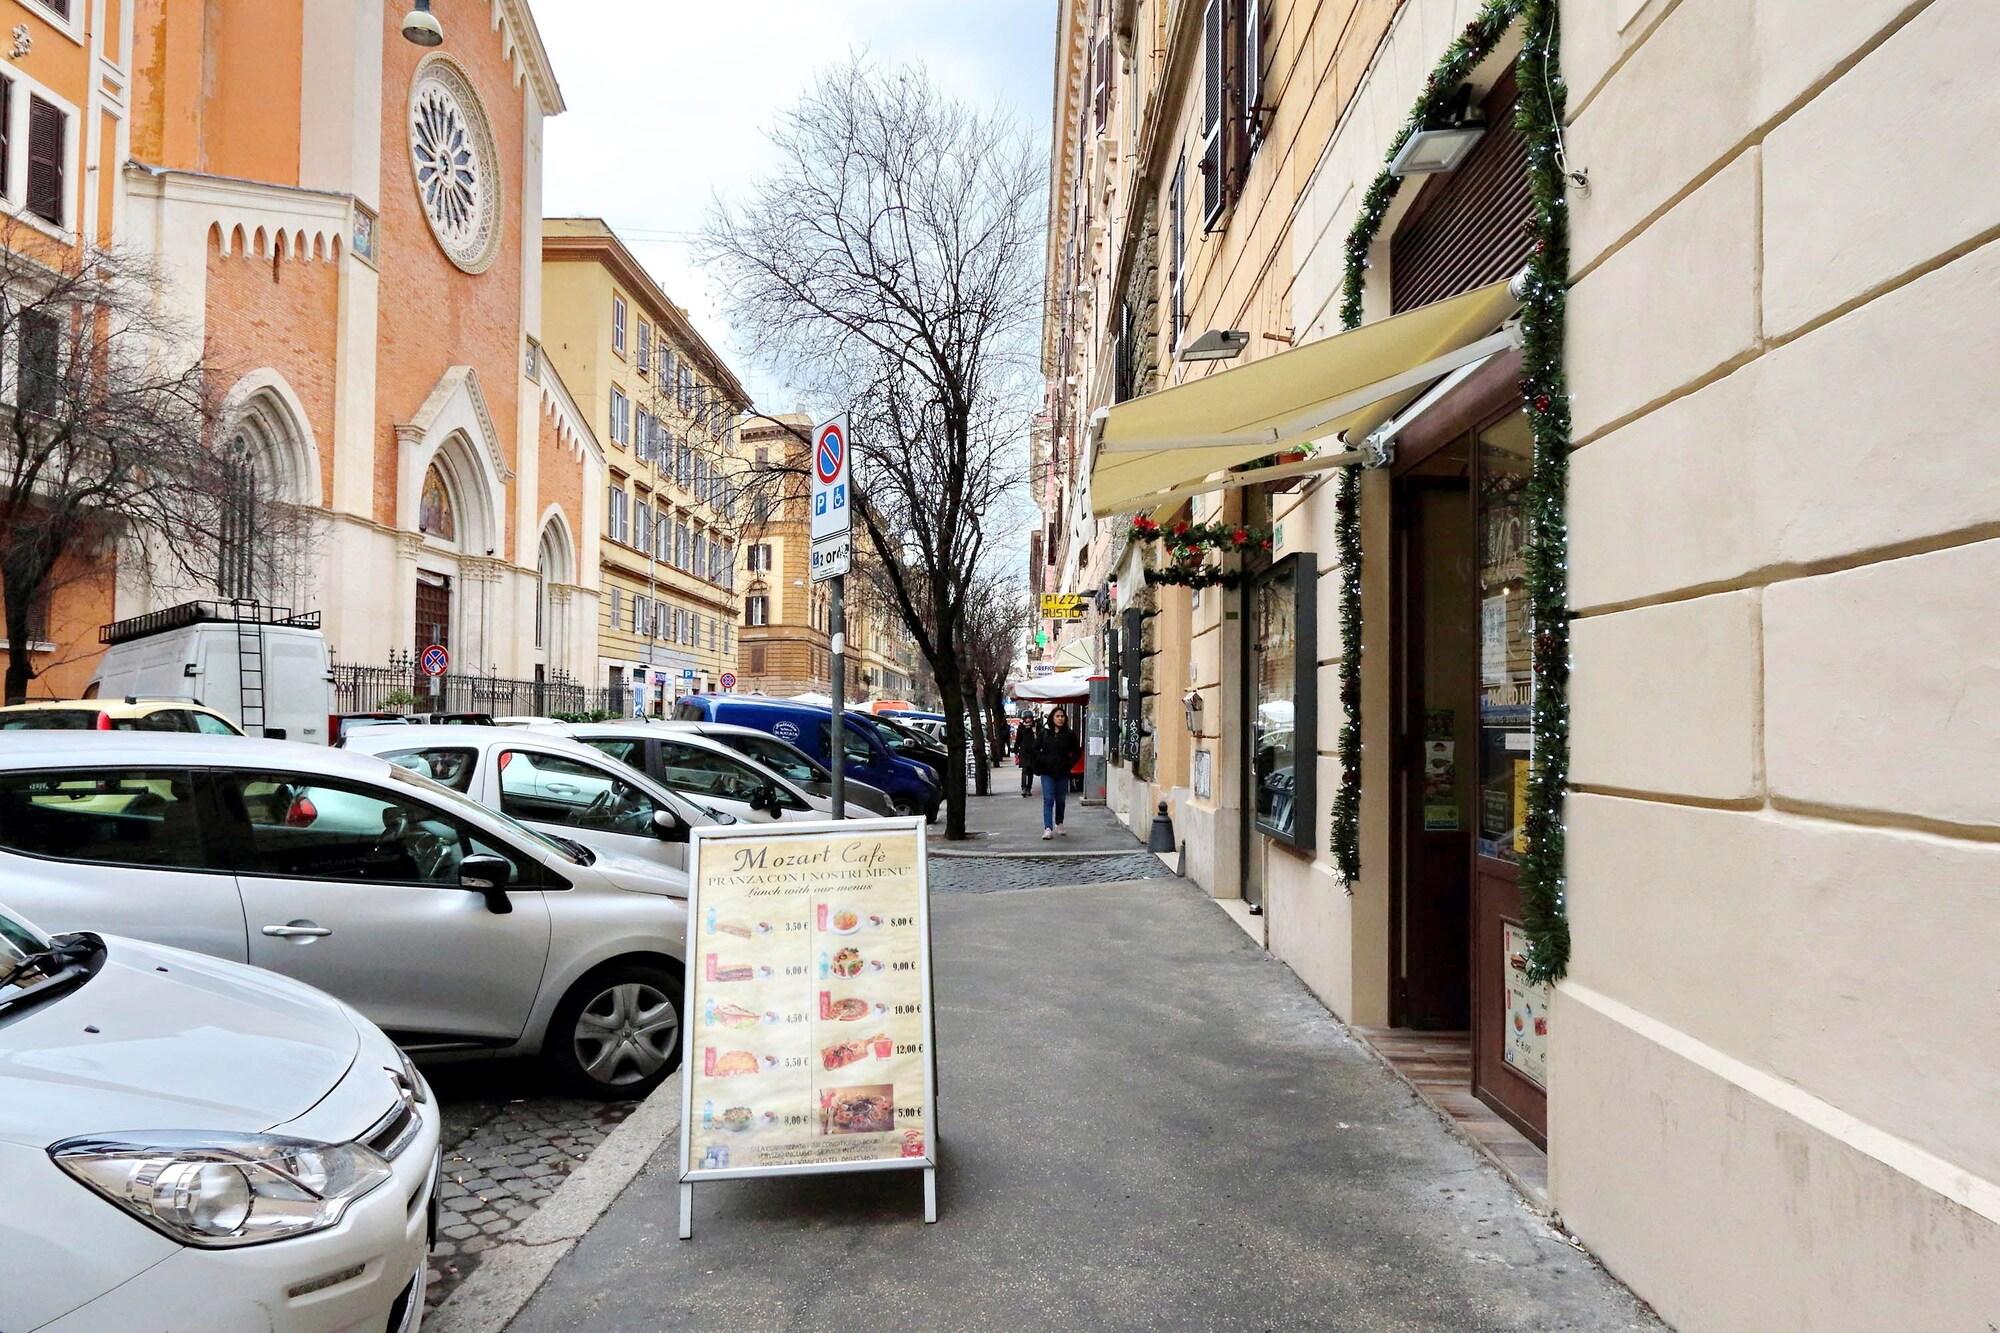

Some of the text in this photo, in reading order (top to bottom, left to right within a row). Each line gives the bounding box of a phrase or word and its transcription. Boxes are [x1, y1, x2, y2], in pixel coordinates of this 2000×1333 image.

[817, 494, 825, 514] P
[1045, 595, 1082, 605] PIZZA
[1042, 608, 1084, 618] RUSTICA
[1487, 687, 1518, 706] PACKED
[733, 843, 831, 872] Mozart
[708, 873, 763, 887] PRANZA
[767, 872, 797, 884] CON
[810, 869, 861, 881] NOSTRI
[784, 884, 810, 895] with
[837, 883, 873, 892] menus
